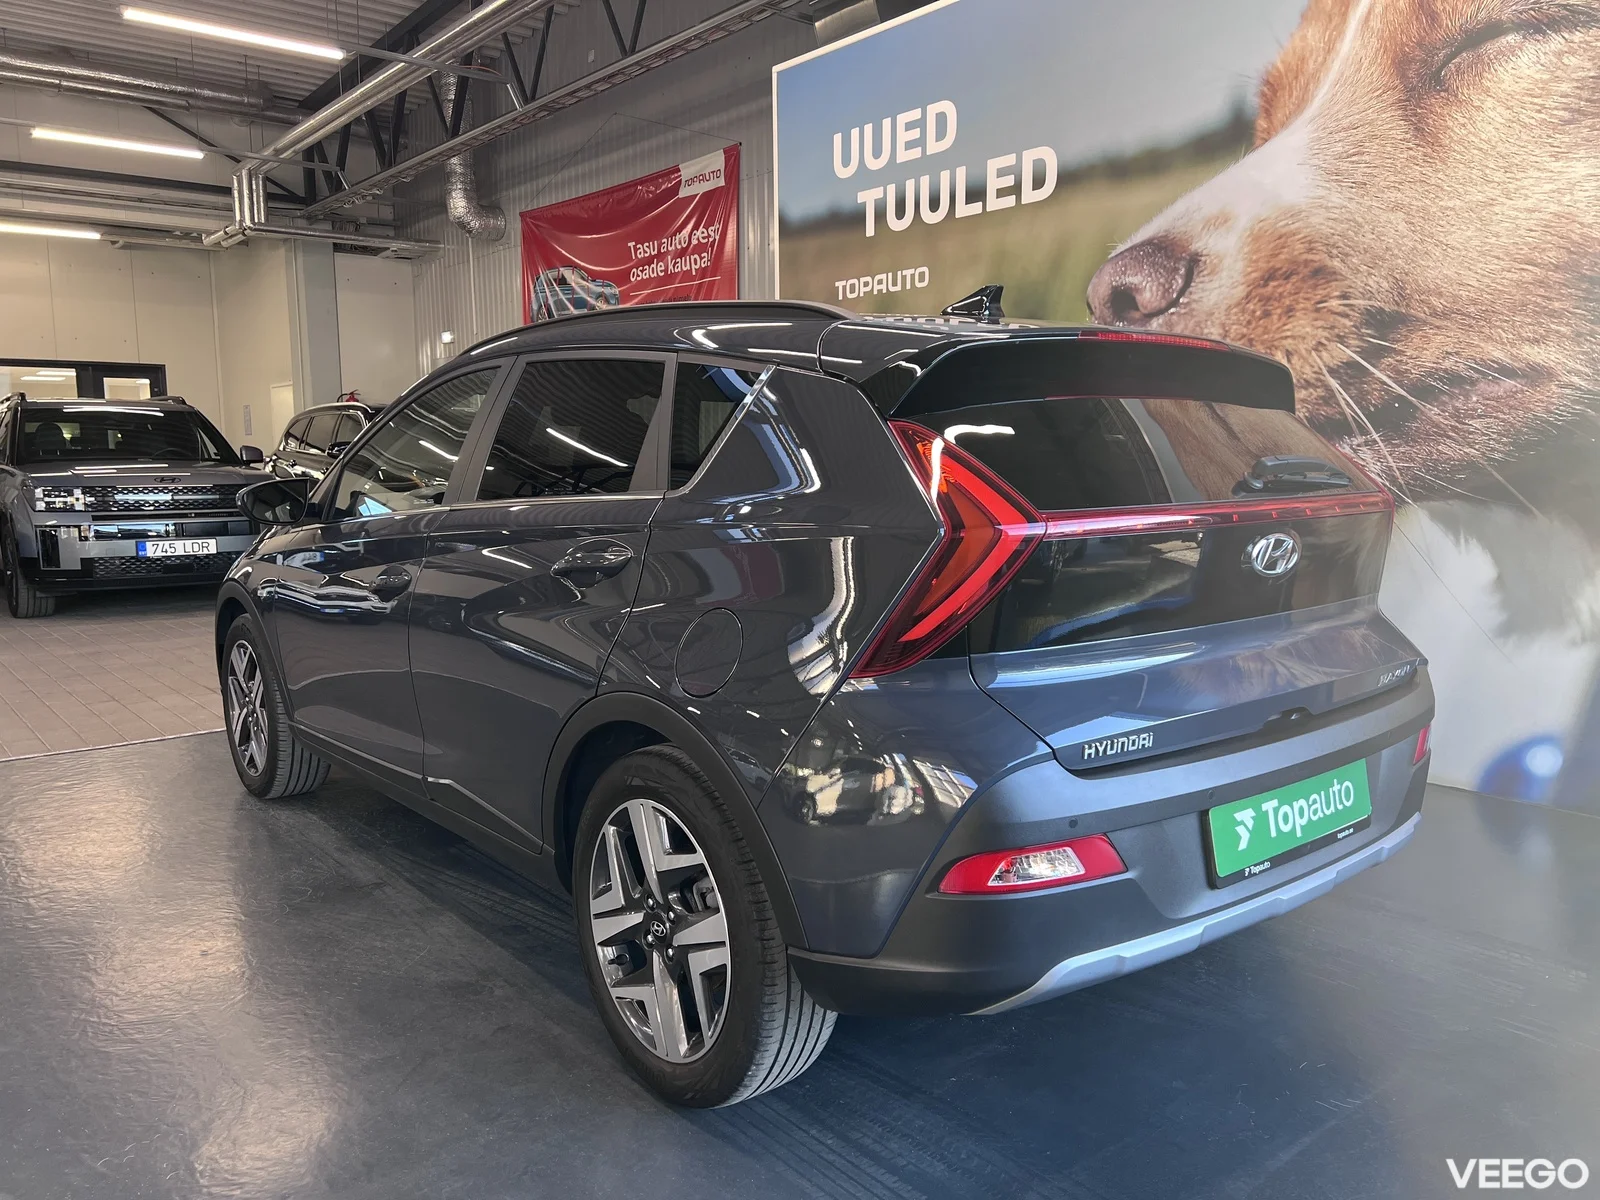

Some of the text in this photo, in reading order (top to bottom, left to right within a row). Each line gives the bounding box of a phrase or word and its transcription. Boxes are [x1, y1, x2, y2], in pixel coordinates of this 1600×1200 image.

[833, 99, 958, 179] UUED
[684, 168, 722, 188] TOPAUTO
[857, 146, 1058, 238] TUULED
[628, 223, 720, 260] Tasu auto eest
[630, 248, 712, 282] osade kaupa!
[835, 266, 929, 300] TOPAUTO
[152, 541, 211, 555] 745 LDR
[1083, 732, 1154, 760] HYUNDAI
[1261, 778, 1355, 838] Topauto
[1250, 861, 1271, 875] Topauto
